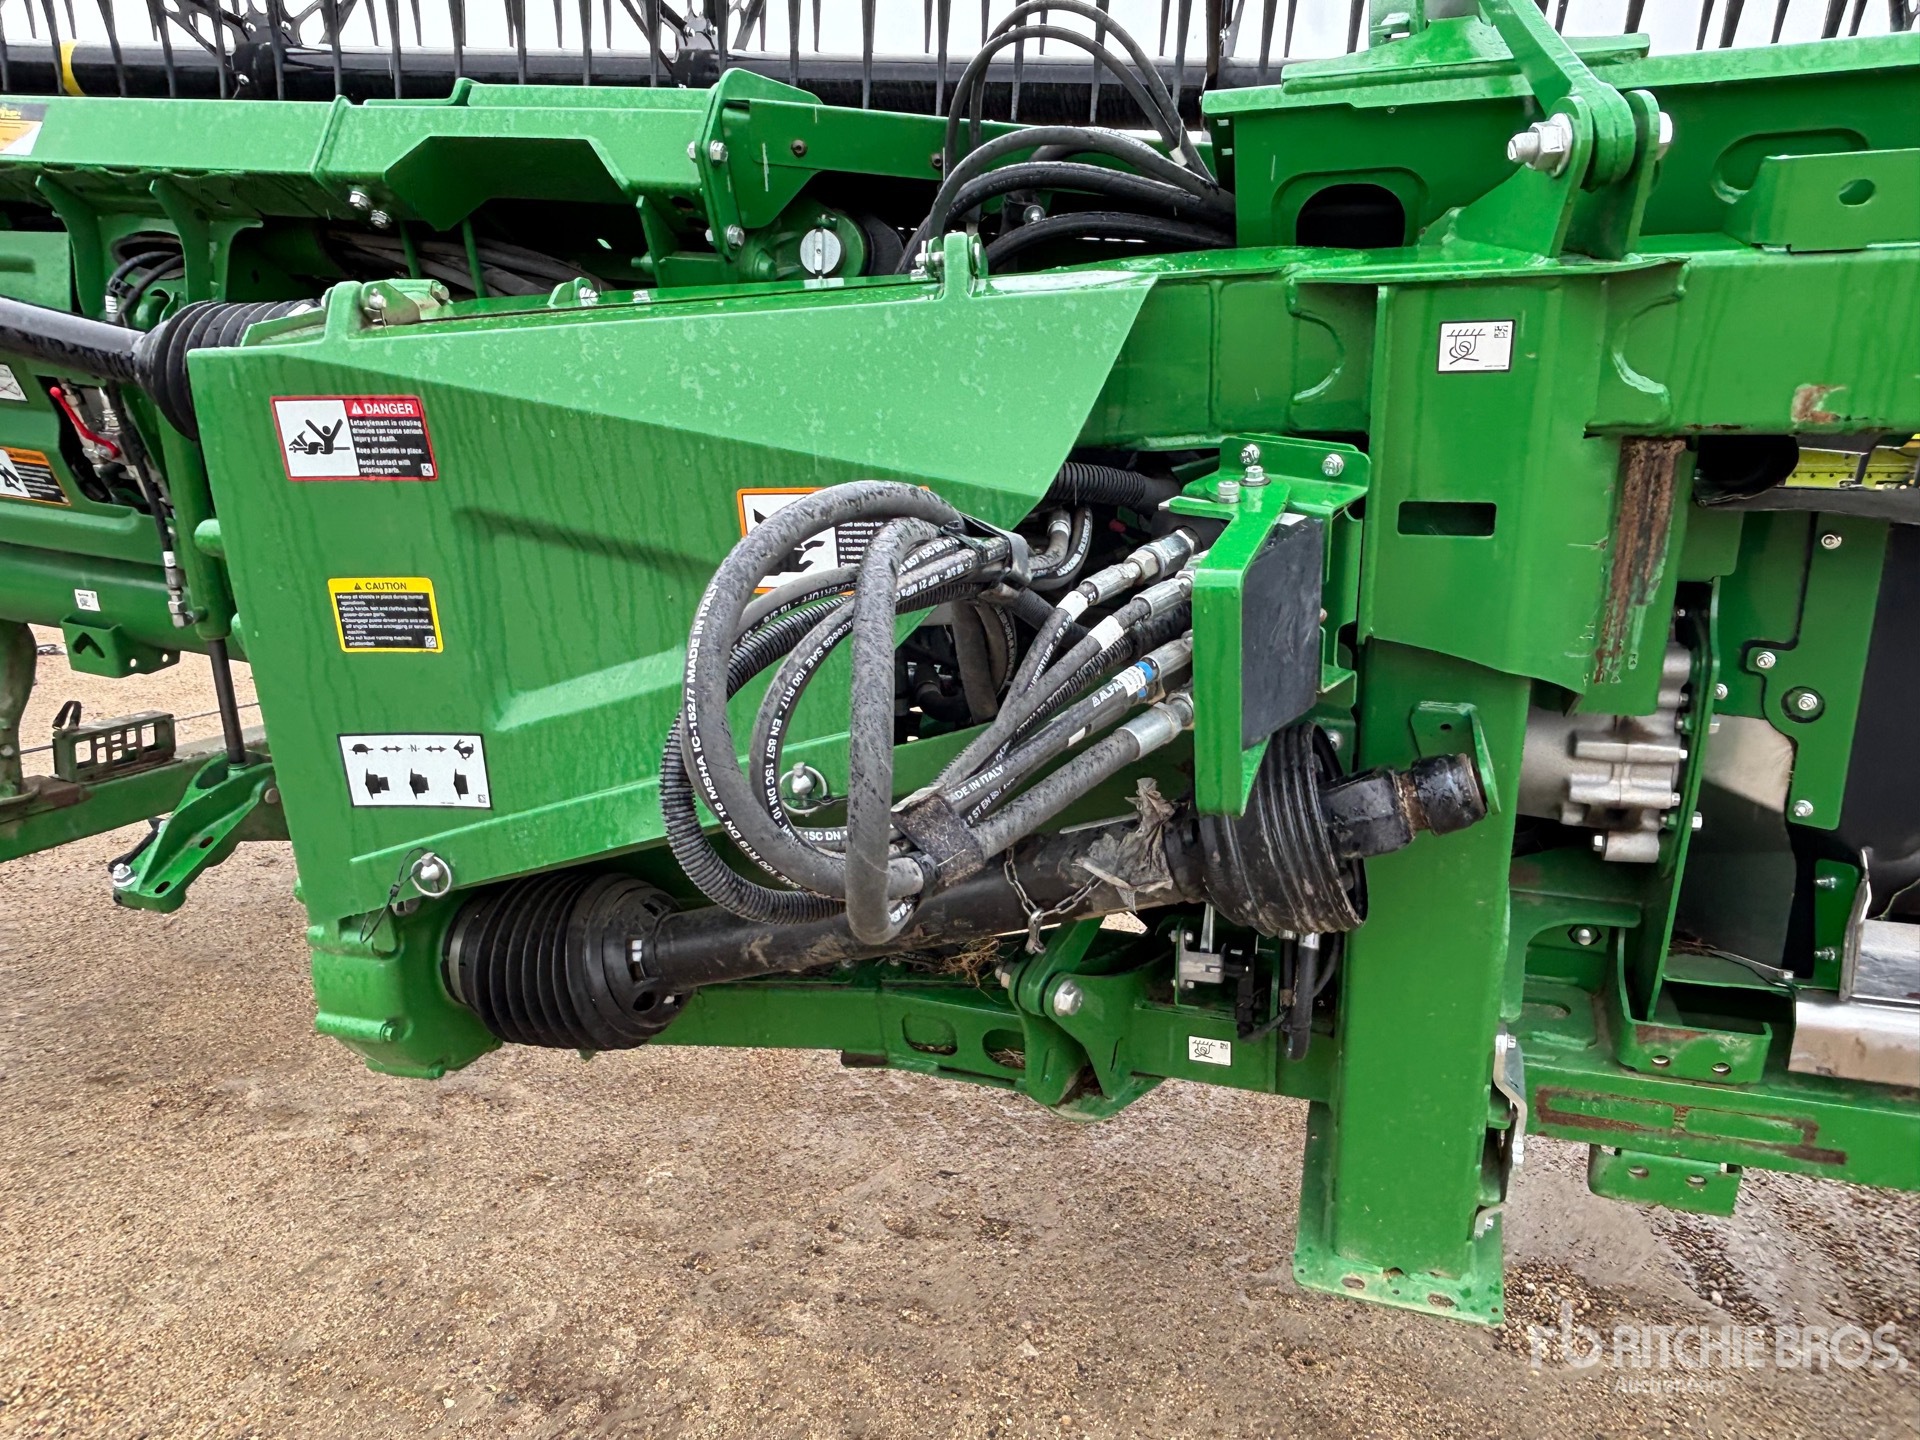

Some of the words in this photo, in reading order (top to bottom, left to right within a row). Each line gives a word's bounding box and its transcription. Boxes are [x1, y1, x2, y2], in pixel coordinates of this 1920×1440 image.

[364, 403, 414, 414] DANGER
[365, 582, 408, 591] CAUTION
[919, 579, 928, 591] 21
[698, 582, 719, 617] ITALY
[693, 619, 705, 636] IN
[686, 637, 701, 684] MADE
[804, 646, 826, 669] SAE
[792, 667, 808, 687] 100
[780, 684, 796, 710] R17
[770, 717, 783, 737] EN
[766, 738, 778, 760] 857
[696, 754, 719, 801] MSHA
[765, 762, 775, 786] 1SC
[969, 780, 981, 792] IN
[979, 764, 1004, 786] ITALY
[766, 786, 779, 807] DN
[771, 805, 782, 821] 10
[972, 808, 983, 820] ST
[980, 799, 992, 810] EN
[724, 819, 742, 838] DN
[824, 830, 842, 842] DN
[759, 860, 778, 876] 100
